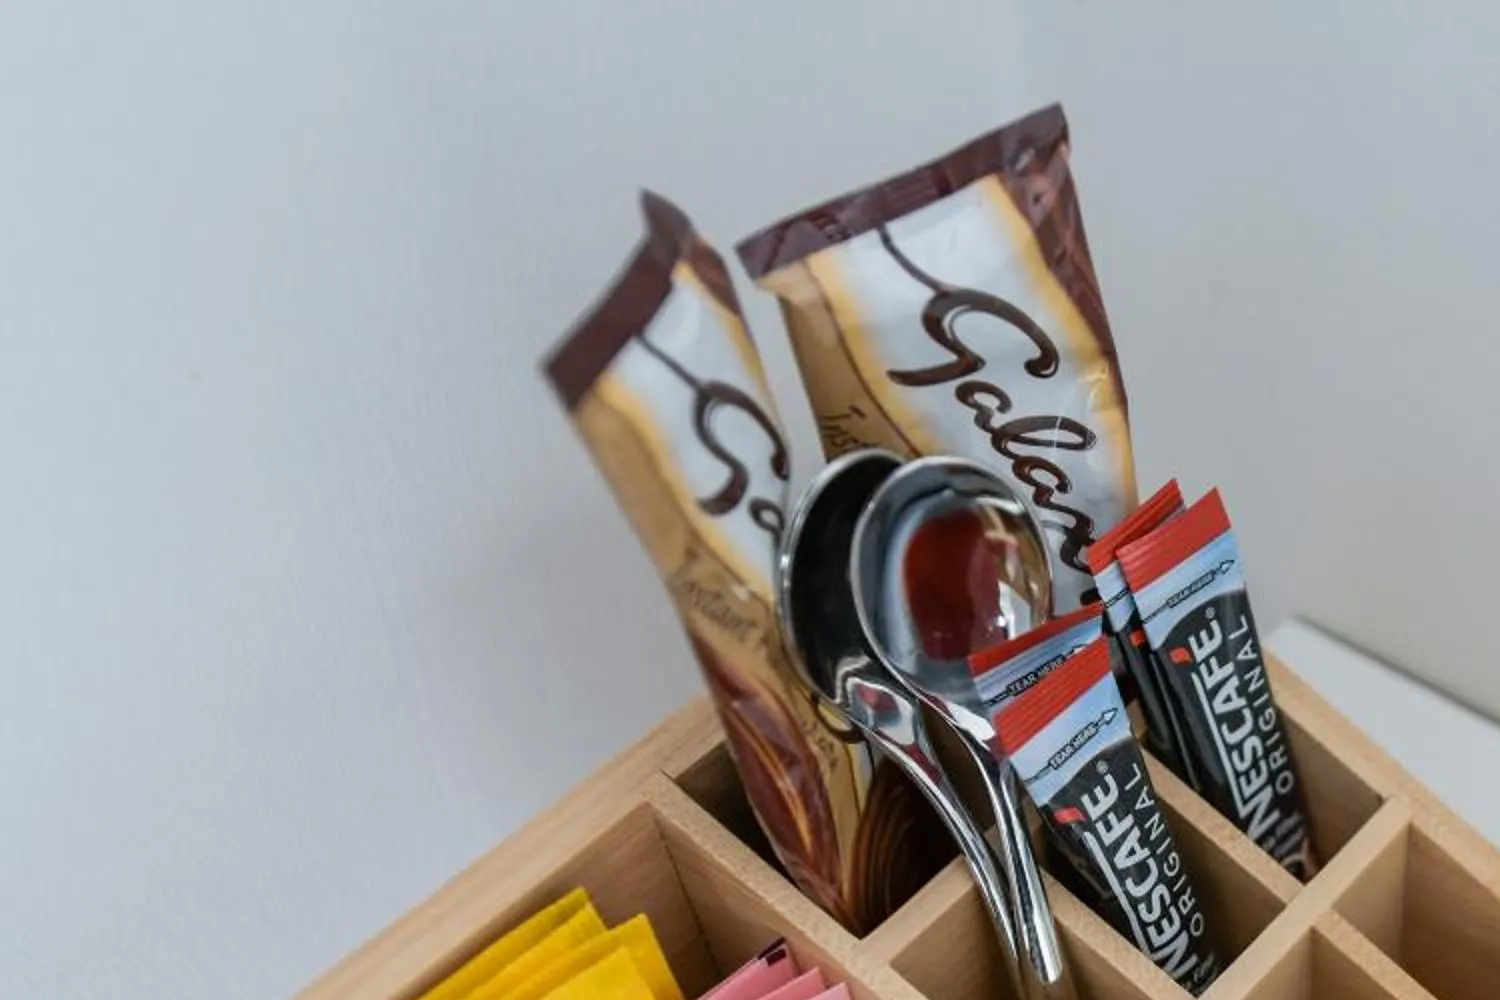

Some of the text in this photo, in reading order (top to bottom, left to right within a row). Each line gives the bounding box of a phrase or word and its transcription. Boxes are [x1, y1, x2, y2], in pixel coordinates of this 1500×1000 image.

[887, 286, 1100, 606] Galax
[1228, 614, 1295, 795] ORIGINAL
[1124, 762, 1204, 937] ORIGINAL
